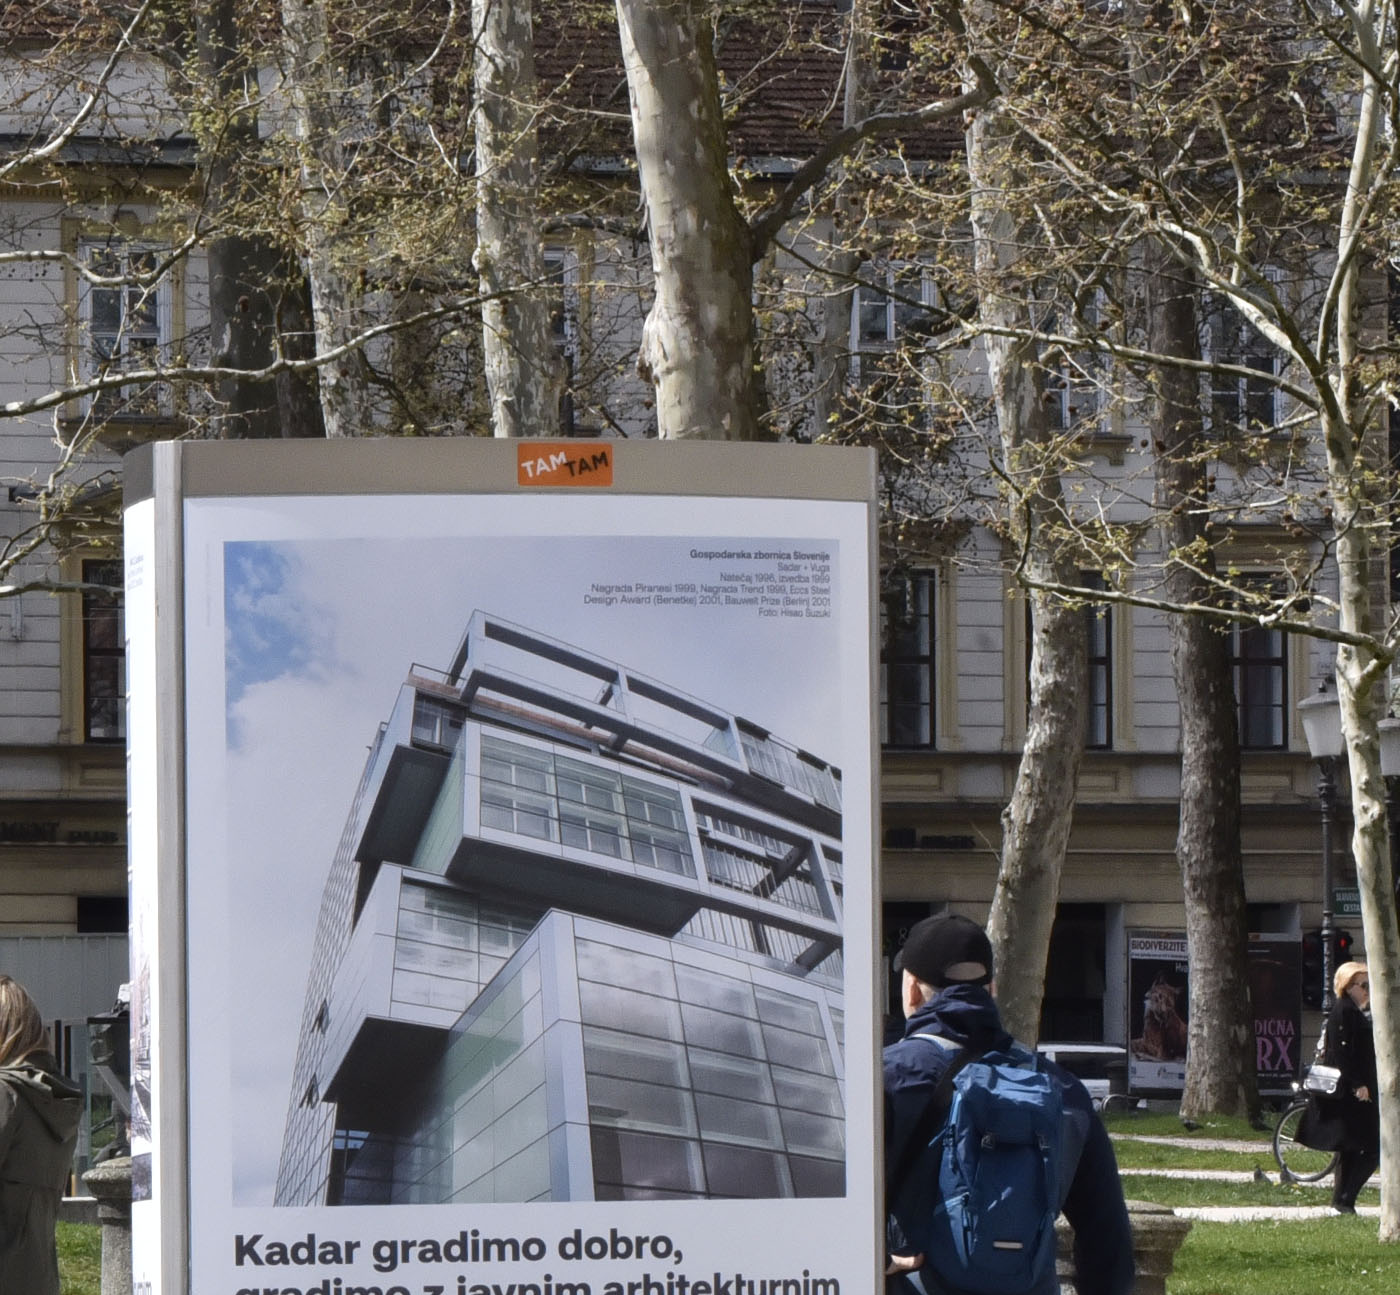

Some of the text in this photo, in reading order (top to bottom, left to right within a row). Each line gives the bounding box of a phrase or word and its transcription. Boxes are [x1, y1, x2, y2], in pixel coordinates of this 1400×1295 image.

[521, 451, 609, 478] TAM TAM
[690, 549, 830, 562] Gospodarska zbornica Slovenije
[777, 562, 801, 572] Sadar
[810, 563, 830, 574] Vuga
[720, 572, 753, 584] Natečaj
[779, 573, 810, 584] izvedba
[591, 583, 633, 595] Nagrada
[635, 583, 672, 593] Piranesi
[701, 584, 739, 596] Nagrada
[741, 584, 764, 594] Trend
[810, 585, 830, 595] Steel
[584, 594, 618, 607] Design
[620, 595, 651, 604] Award
[653, 595, 697, 607] (Benetke)
[725, 596, 759, 606] Bauwelt
[761, 596, 780, 606] Prize
[780, 607, 802, 617] Hisao
[234, 1228, 683, 1273] Kadar gradimo dobro,
